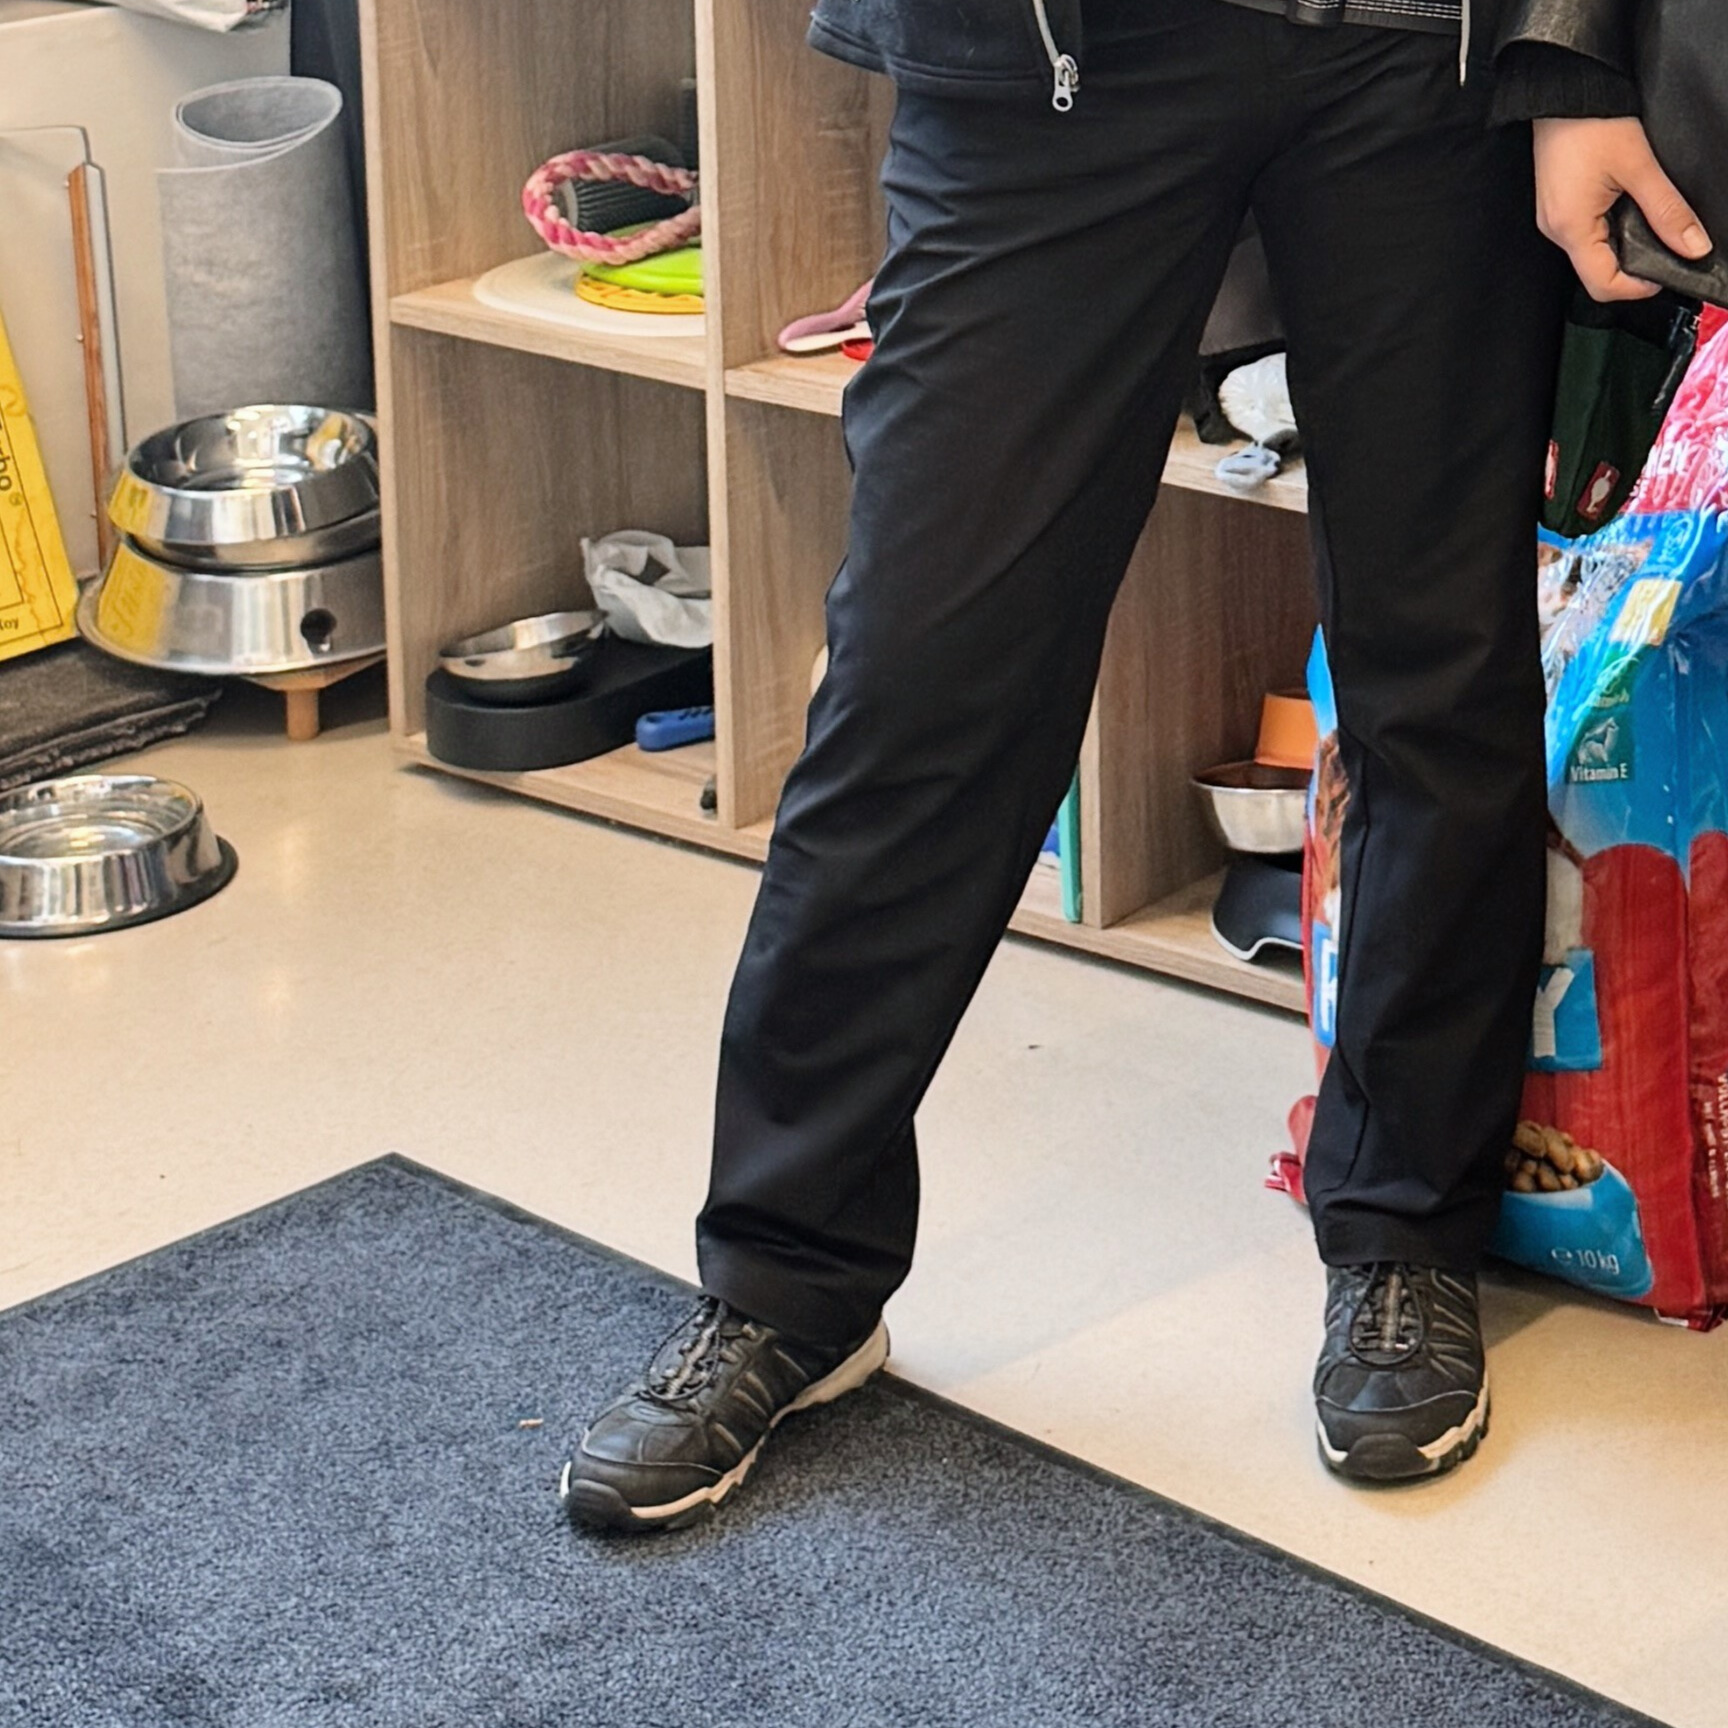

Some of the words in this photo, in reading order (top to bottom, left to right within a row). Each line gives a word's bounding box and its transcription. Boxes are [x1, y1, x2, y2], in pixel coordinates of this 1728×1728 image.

[1619, 762, 1629, 779] E
[1575, 1248, 1597, 1269] 10
[1596, 1247, 1621, 1276] kg
